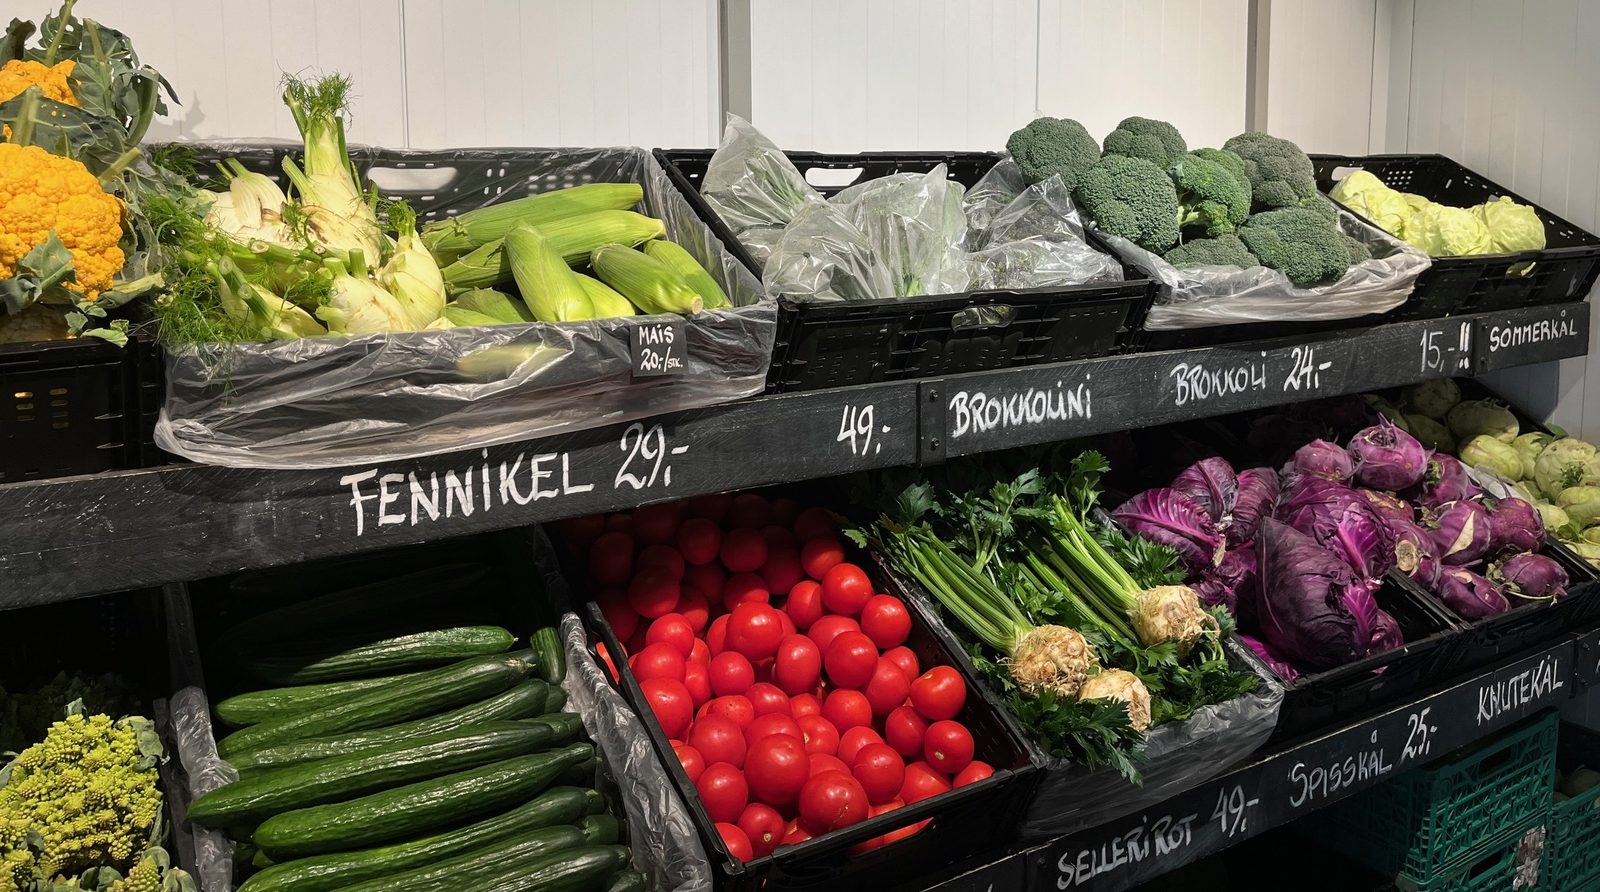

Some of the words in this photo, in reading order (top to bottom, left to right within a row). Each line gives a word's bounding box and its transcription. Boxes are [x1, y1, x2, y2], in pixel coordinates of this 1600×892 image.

[1170, 350, 1266, 407] BROKKOLI
[1284, 345, 1332, 391] 24,-
[837, 404, 891, 456] 49,-
[340, 448, 595, 536] FENNIKEL
[615, 423, 690, 490] 29,-
[1288, 730, 1392, 808] SPISSKÅL
[1209, 784, 1259, 838] 49,-
